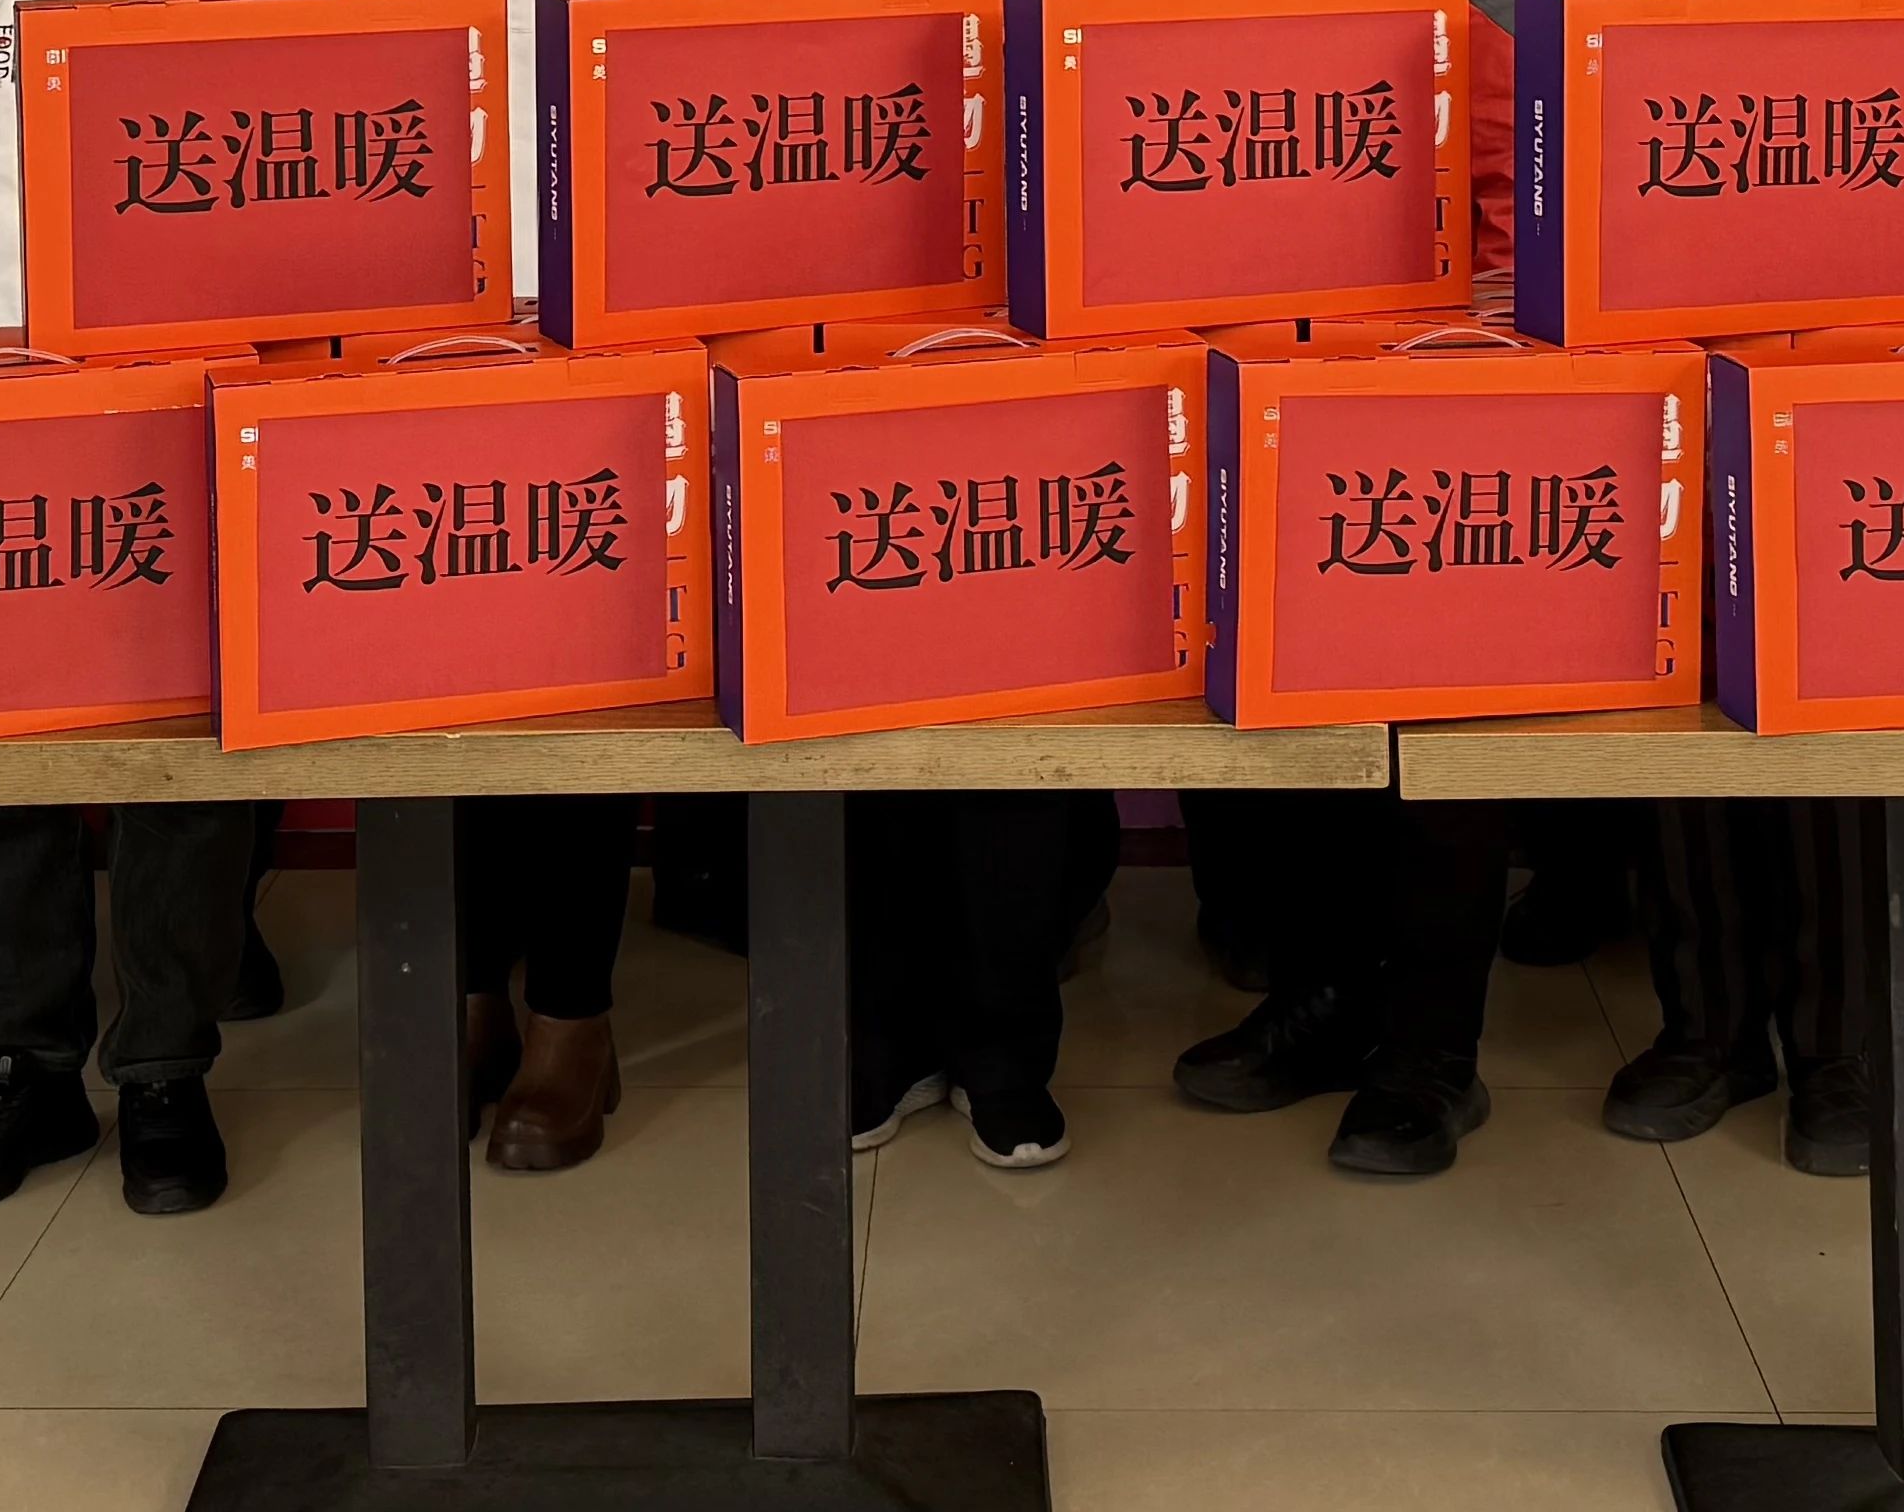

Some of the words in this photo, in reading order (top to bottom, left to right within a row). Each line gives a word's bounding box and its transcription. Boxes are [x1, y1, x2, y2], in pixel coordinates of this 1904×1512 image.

[114, 99, 434, 215] 送温暖
[645, 83, 932, 198] 送温暖
[1119, 82, 1402, 194] 送温暖
[302, 467, 629, 594] 送温暖
[825, 461, 1135, 594] 送温暖
[1317, 465, 1625, 576] 送温暖
